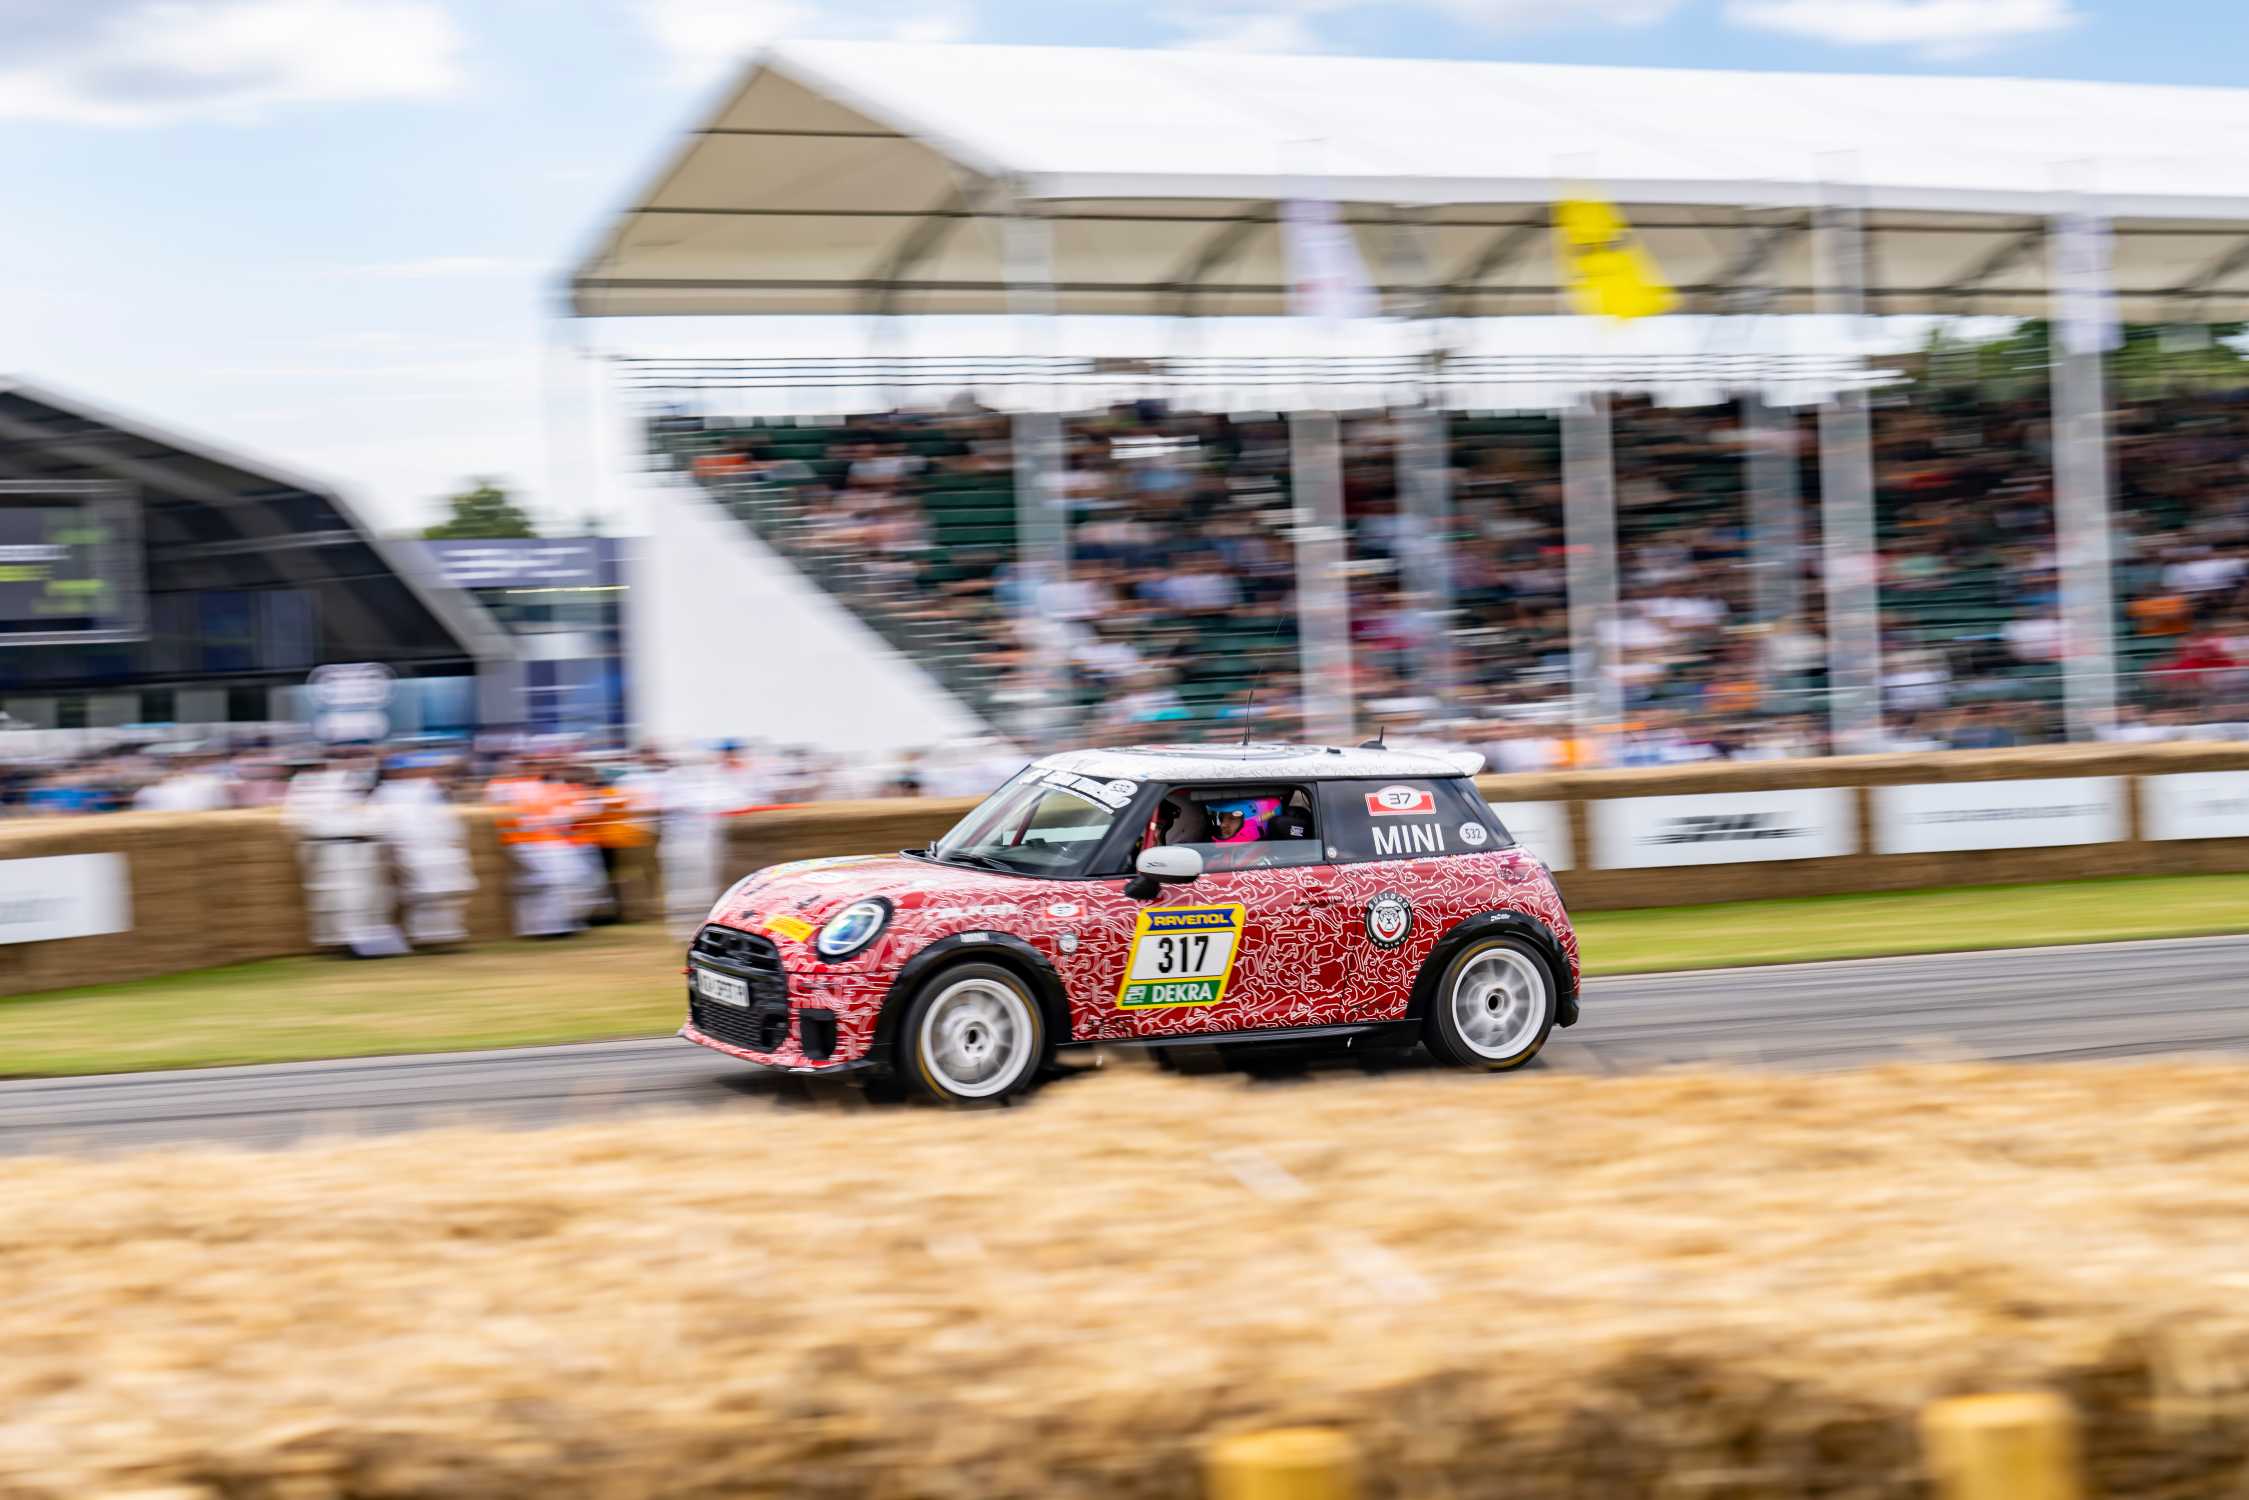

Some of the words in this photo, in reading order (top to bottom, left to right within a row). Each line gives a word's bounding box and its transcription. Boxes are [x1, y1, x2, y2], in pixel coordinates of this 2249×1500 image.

[1388, 792, 1411, 805] 37
[1371, 823, 1445, 856] MINI
[1464, 828, 1482, 840] 532
[1368, 893, 1409, 910] BULLDOG
[1153, 913, 1229, 926] RAVENOL
[1158, 935, 1209, 973] 317
[1151, 982, 1213, 1003] DEKRA
